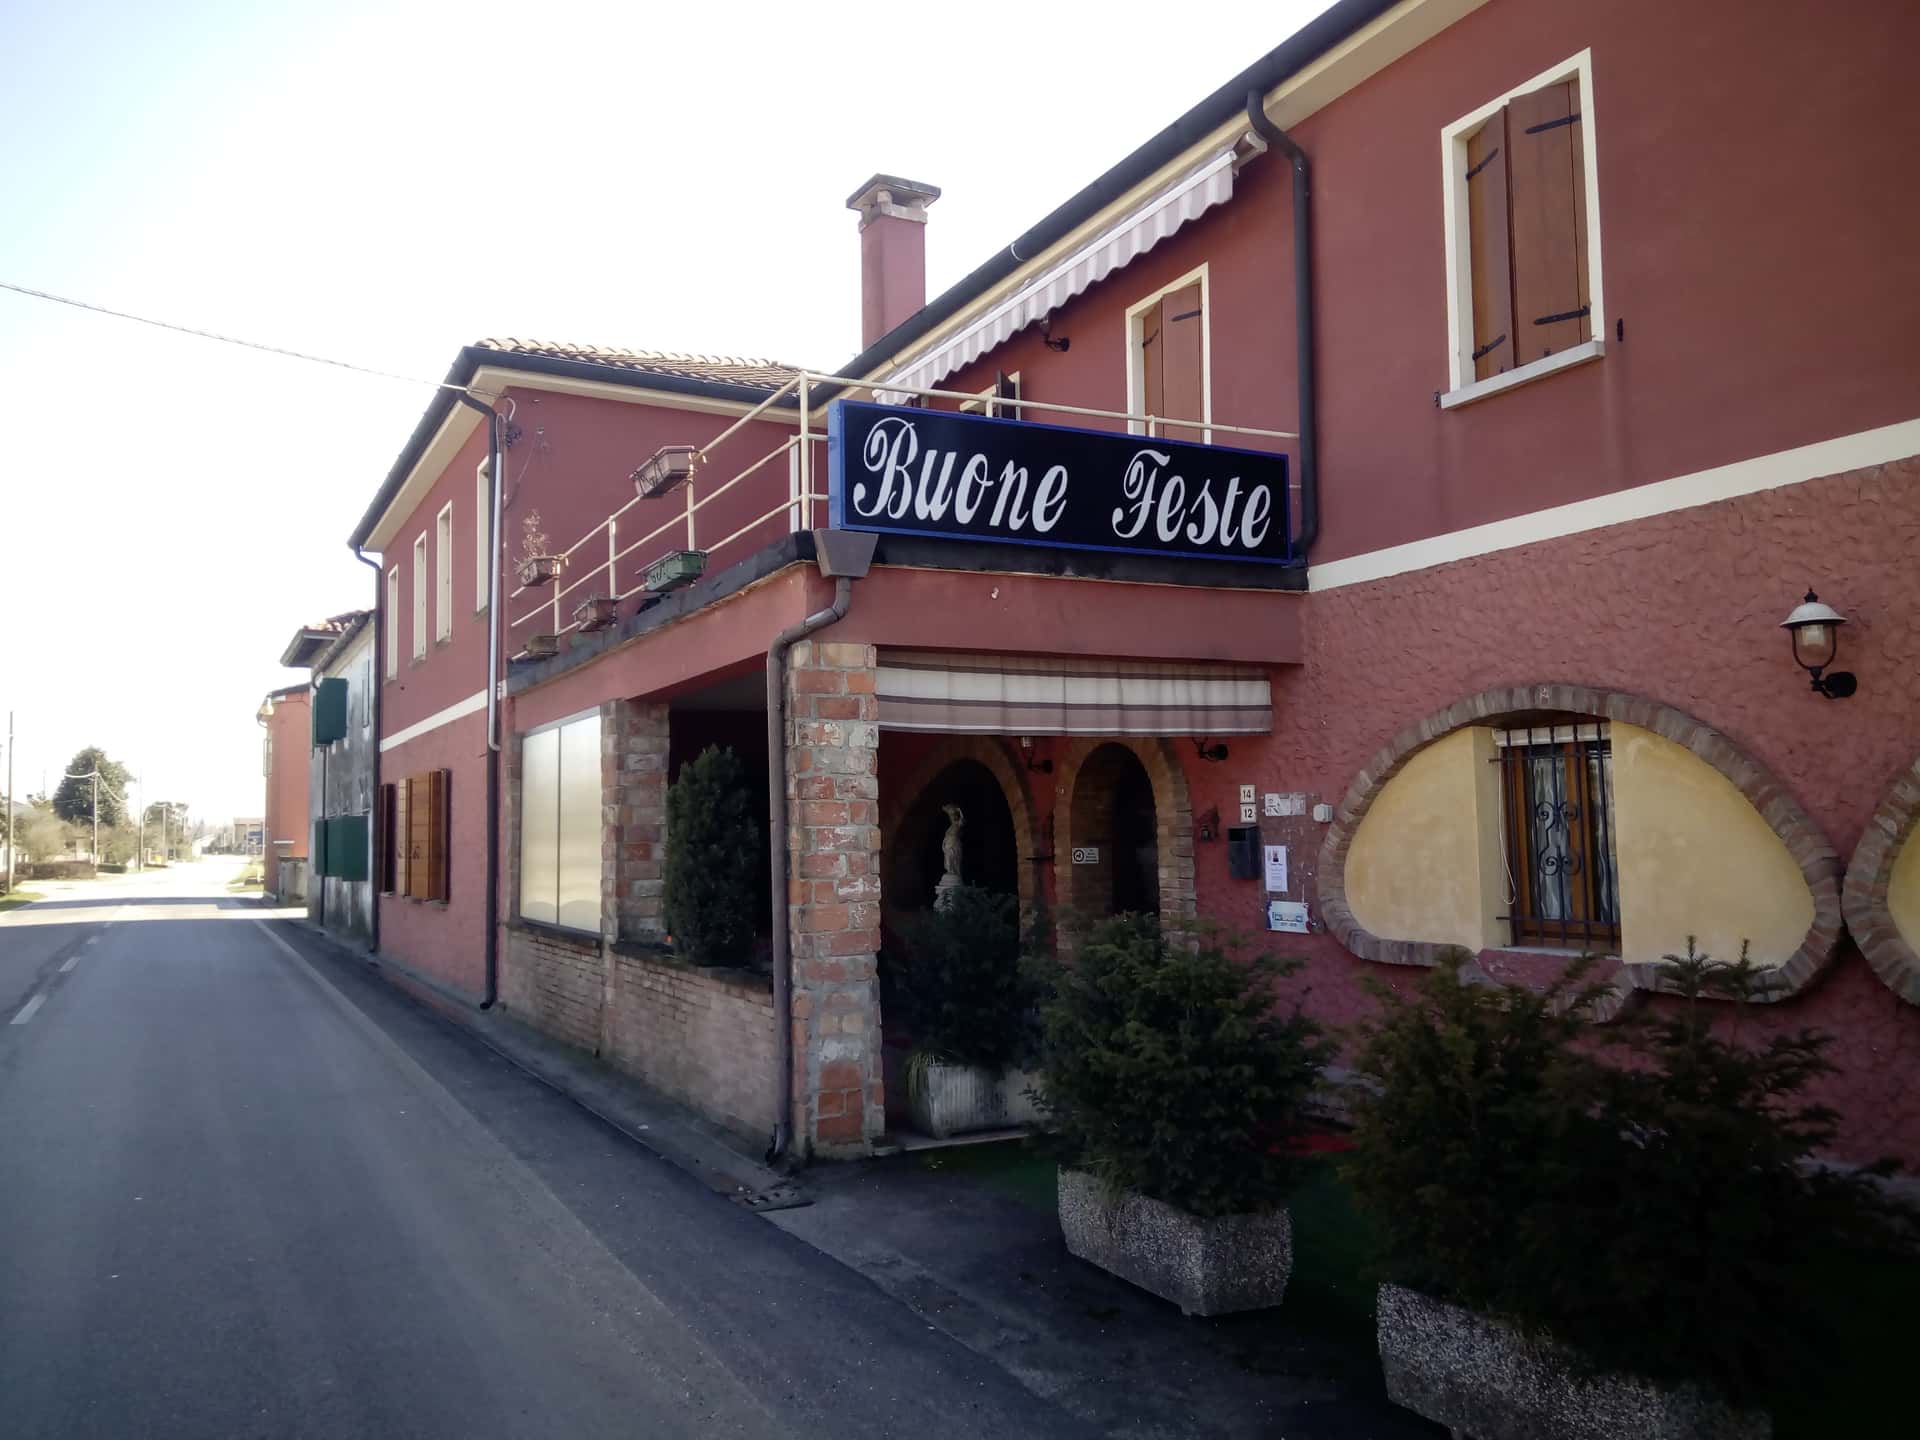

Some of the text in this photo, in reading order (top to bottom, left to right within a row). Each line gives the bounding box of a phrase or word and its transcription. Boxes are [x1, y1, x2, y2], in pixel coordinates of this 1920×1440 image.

[853, 417, 1271, 548] Buone Feste
[1243, 789, 1252, 800] 14
[1244, 808, 1253, 818] 12
